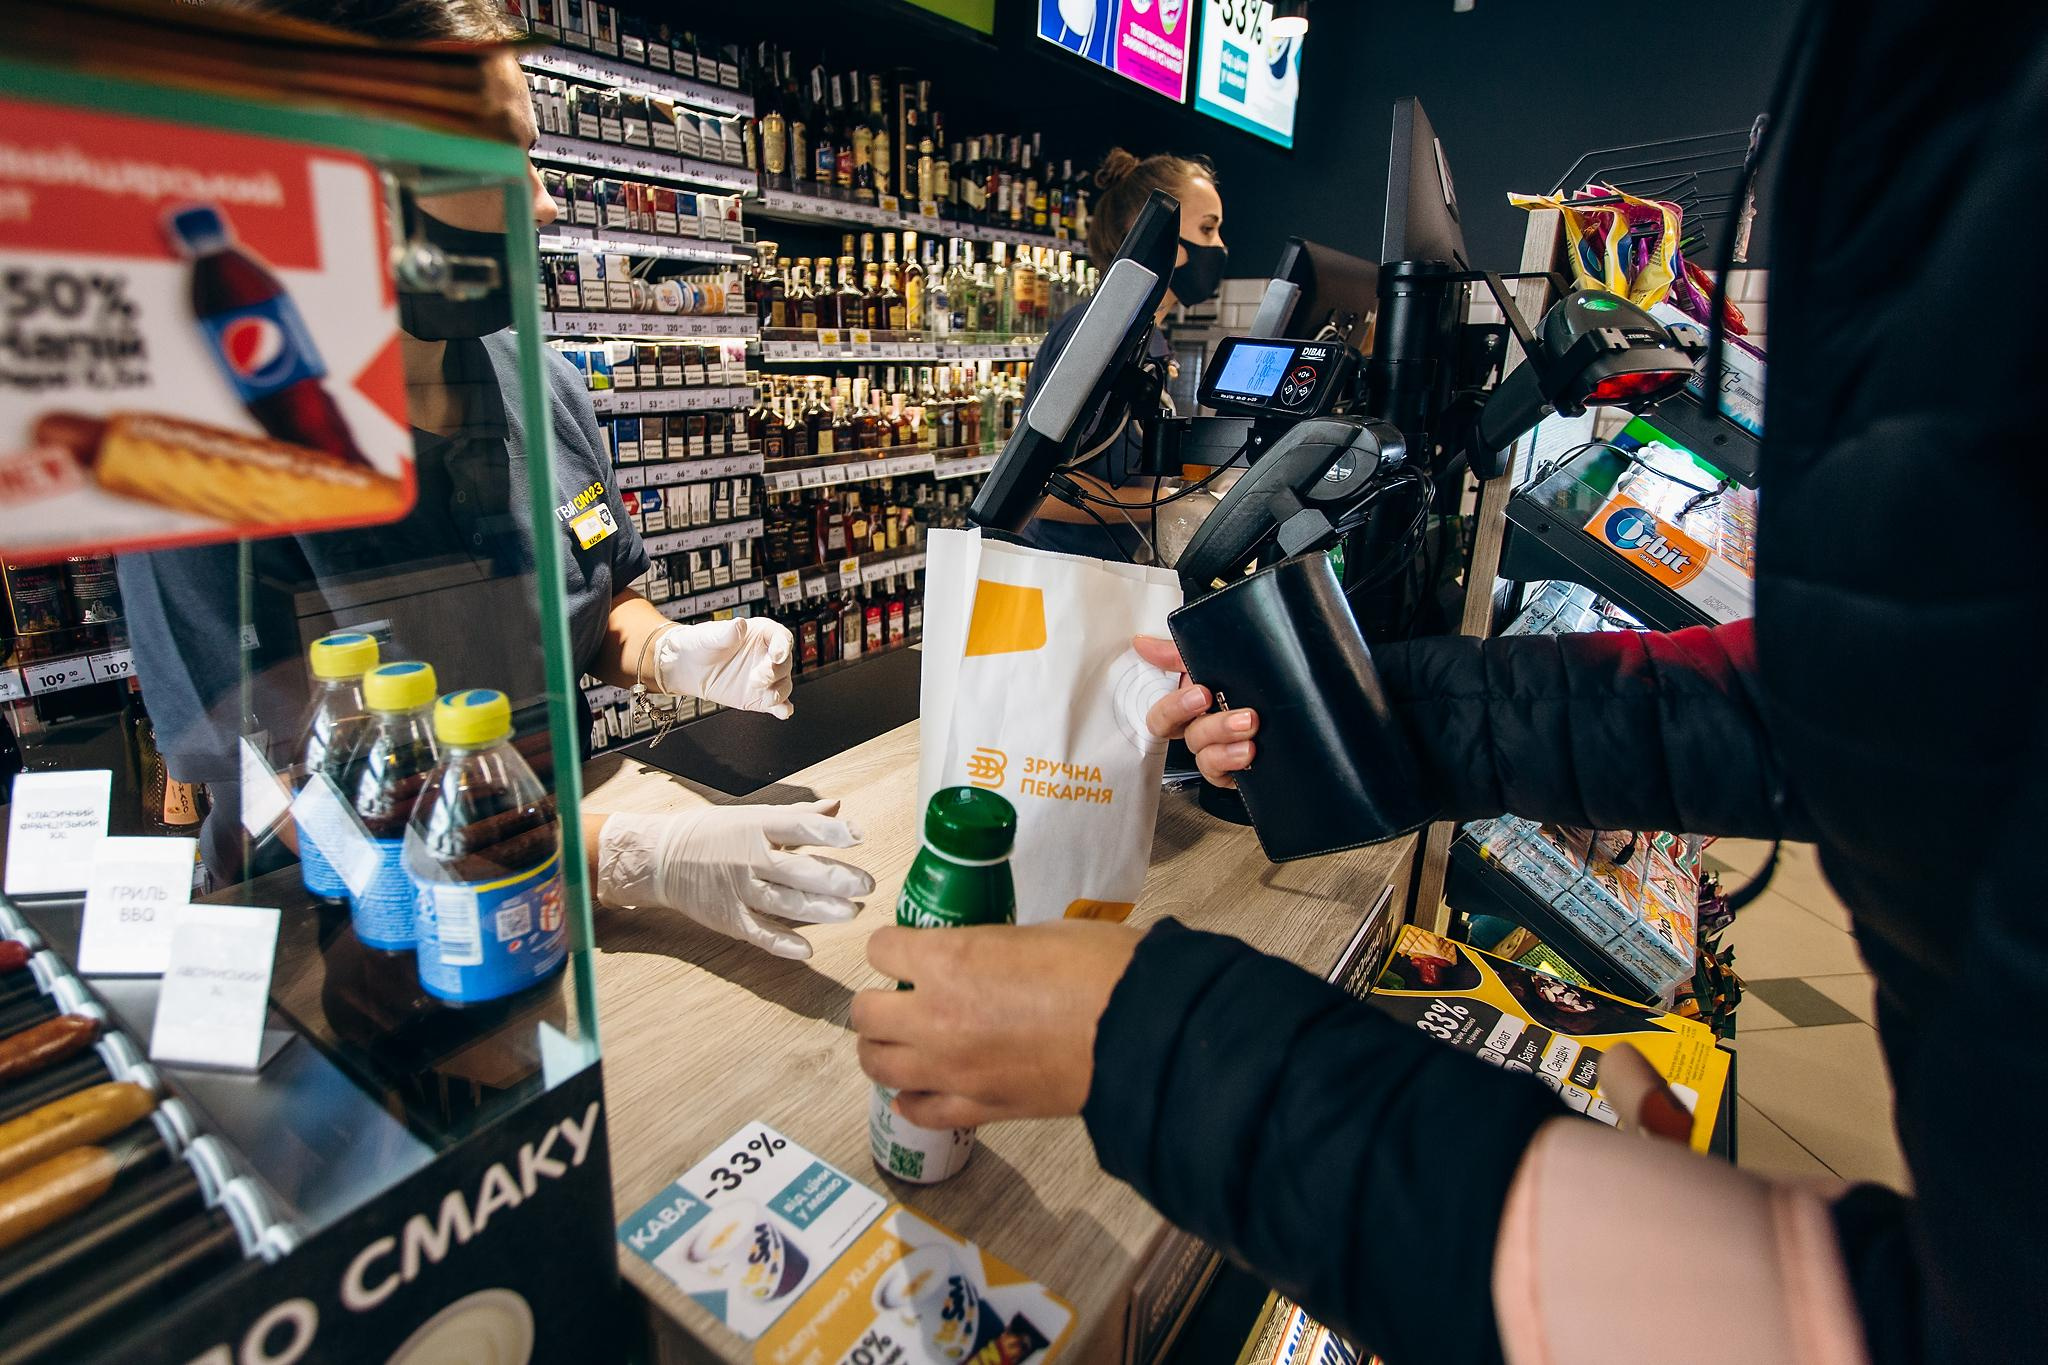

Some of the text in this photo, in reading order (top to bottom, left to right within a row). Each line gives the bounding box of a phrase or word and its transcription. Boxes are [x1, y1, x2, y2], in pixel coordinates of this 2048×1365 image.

[1301, 346, 1327, 358] DIBAL
[1604, 507, 1692, 575] Orbit
[39, 672, 66, 688] 109
[104, 661, 129, 676] 109
[1024, 757, 1102, 783] ЗРУЧНА
[1020, 778, 1114, 804] ПЕКАРНЯ
[110, 885, 169, 901] ГРИЛЬ
[120, 907, 156, 922] BBQ
[1491, 1029, 1513, 1051] Салат
[1546, 1045, 1572, 1073] Сандвіч
[1574, 1060, 1598, 1086] Мафін
[704, 1132, 787, 1200] -33%
[340, 1100, 600, 1313] СМАКУ
[628, 1196, 698, 1250] КАВА
